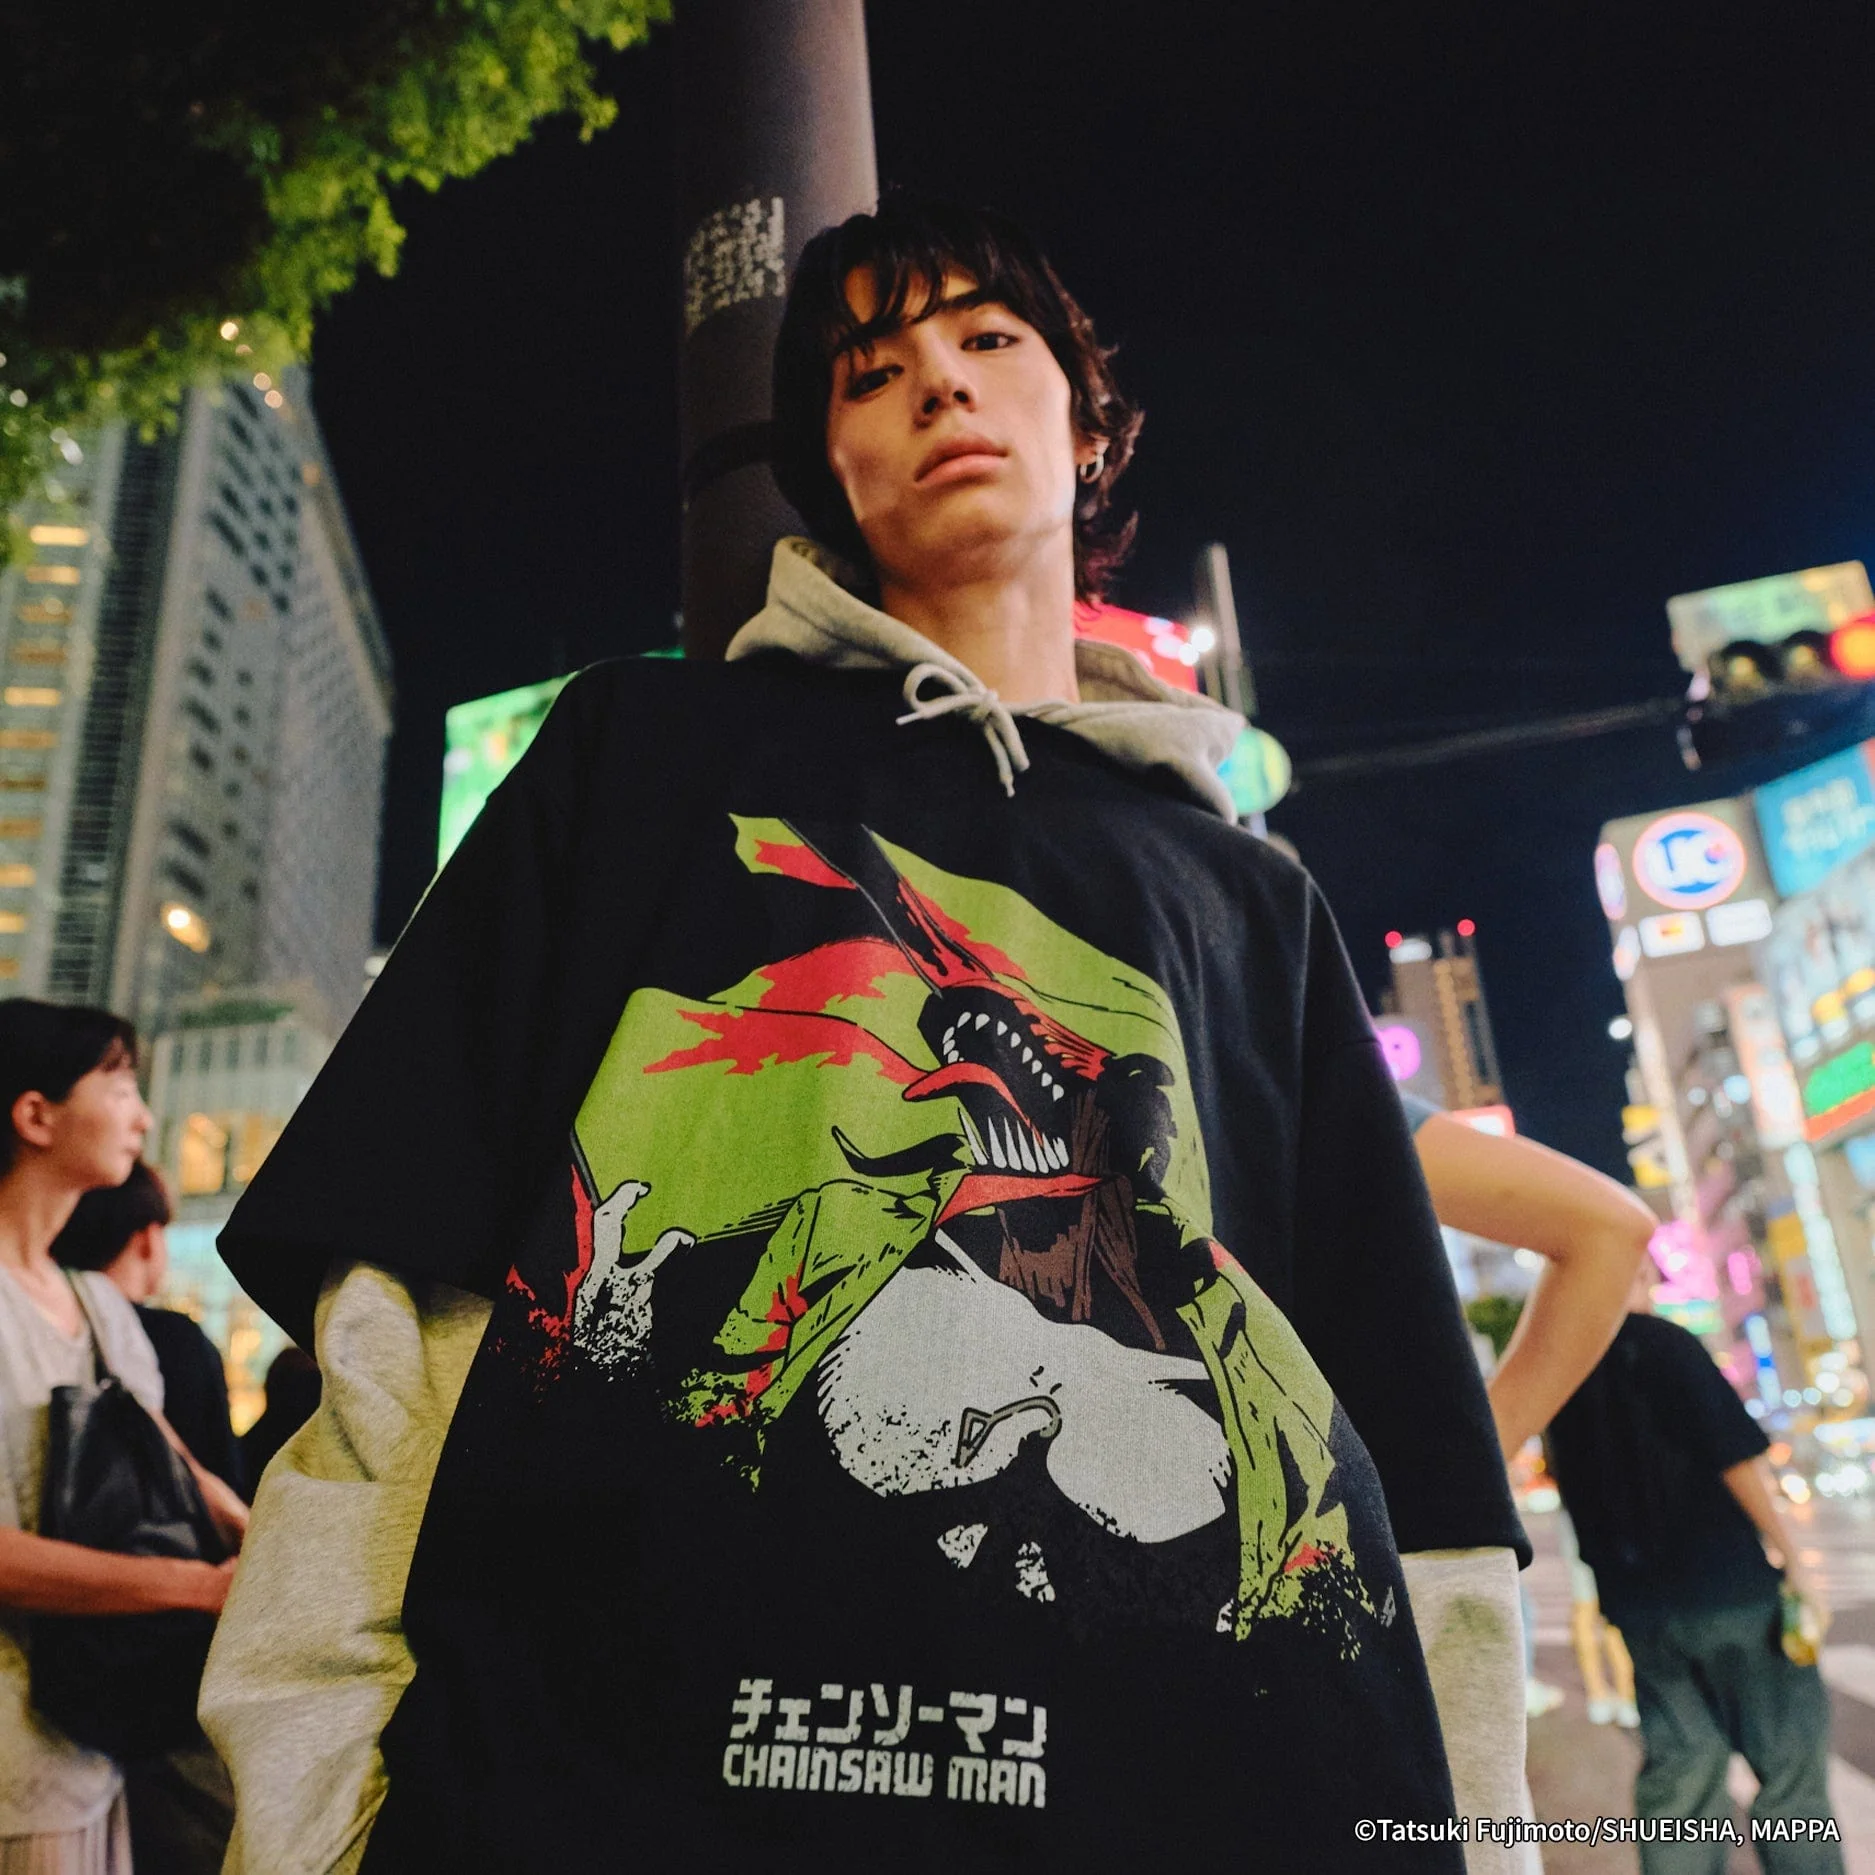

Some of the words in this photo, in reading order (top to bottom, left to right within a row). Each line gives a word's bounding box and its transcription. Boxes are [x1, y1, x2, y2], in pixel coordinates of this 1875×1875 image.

[729, 1678, 1047, 1759] チェンソーマン
[722, 1743, 934, 1797] CHAINSAW
[947, 1756, 1047, 1809] MAN
